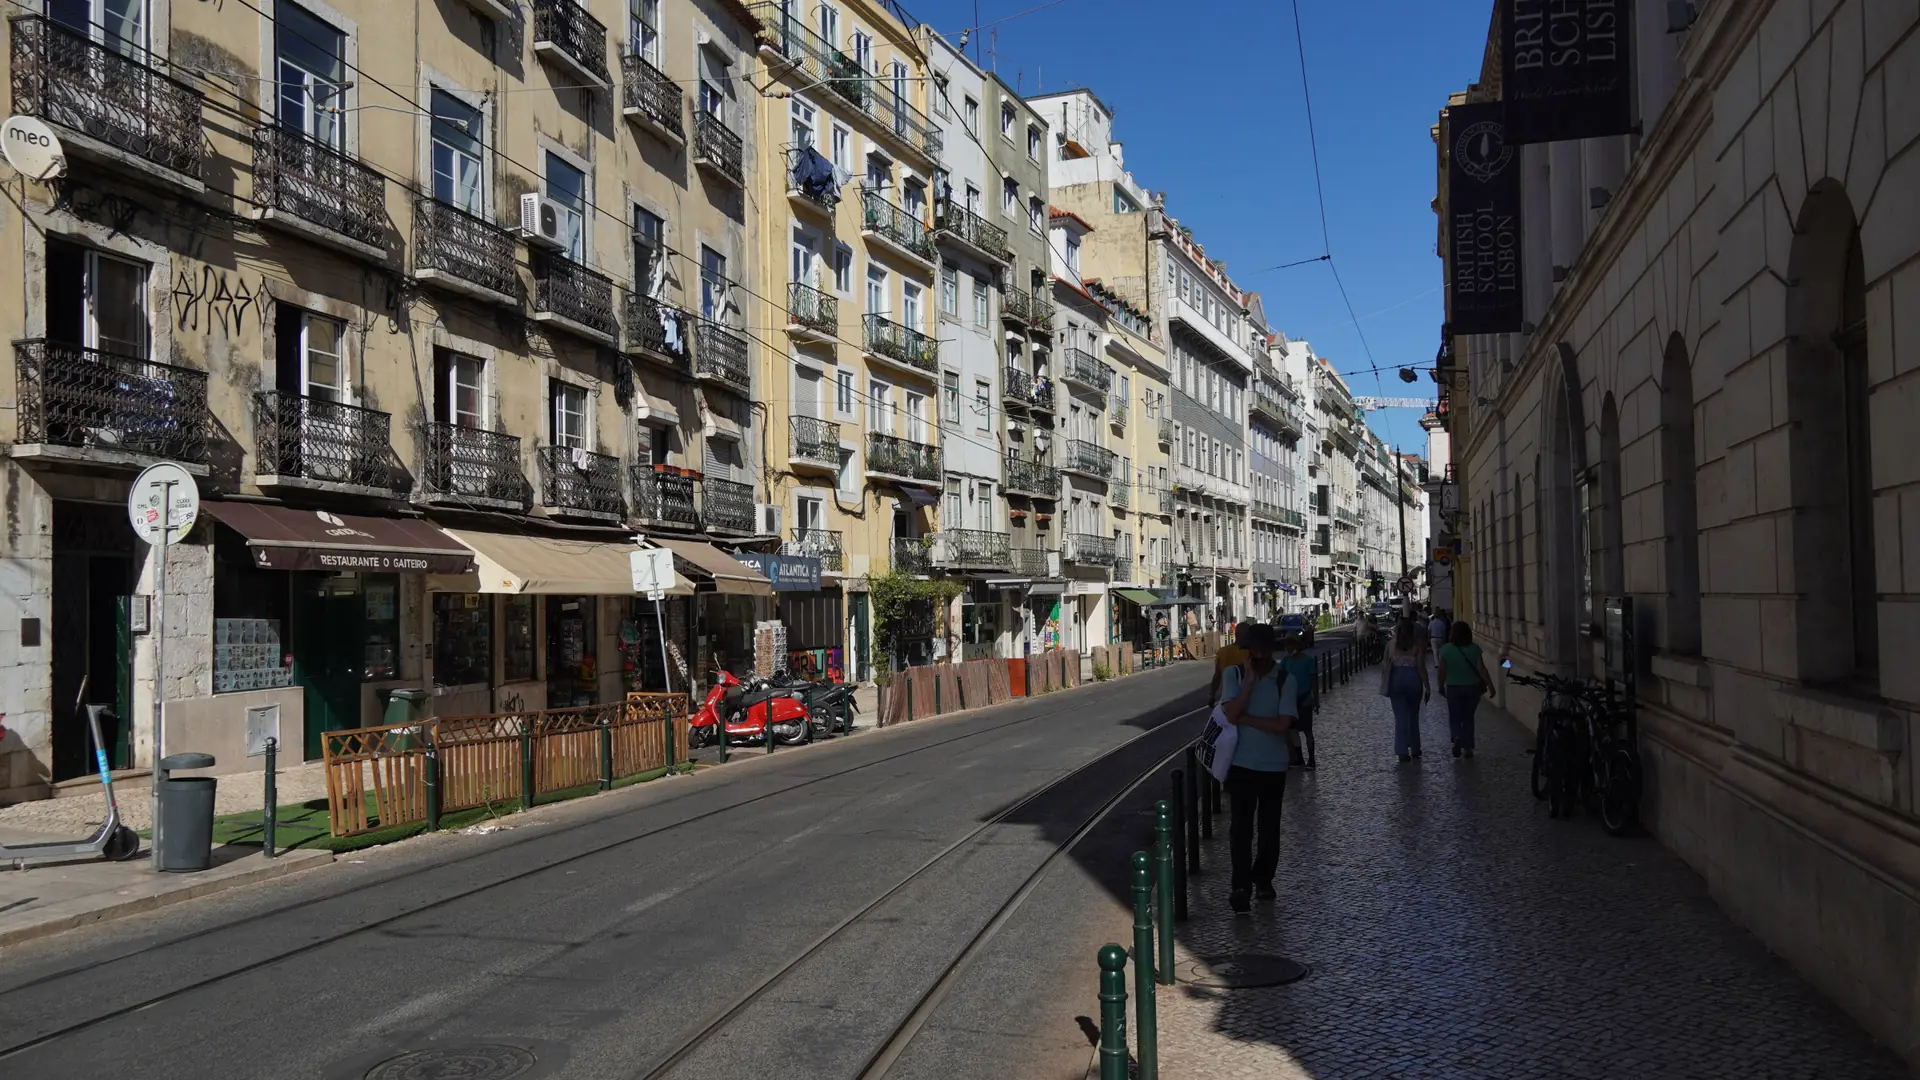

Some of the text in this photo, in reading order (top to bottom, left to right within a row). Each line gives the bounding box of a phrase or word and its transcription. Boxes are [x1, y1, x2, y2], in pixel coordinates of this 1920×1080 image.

[10, 127, 50, 147] meo
[1456, 212, 1475, 293] BRITISH
[1475, 200, 1496, 292] SCHOOL
[1496, 214, 1516, 291] LISBON
[320, 554, 428, 569] RESTAURANTE O GAITEIRO
[778, 563, 810, 577] ATLANTICA
